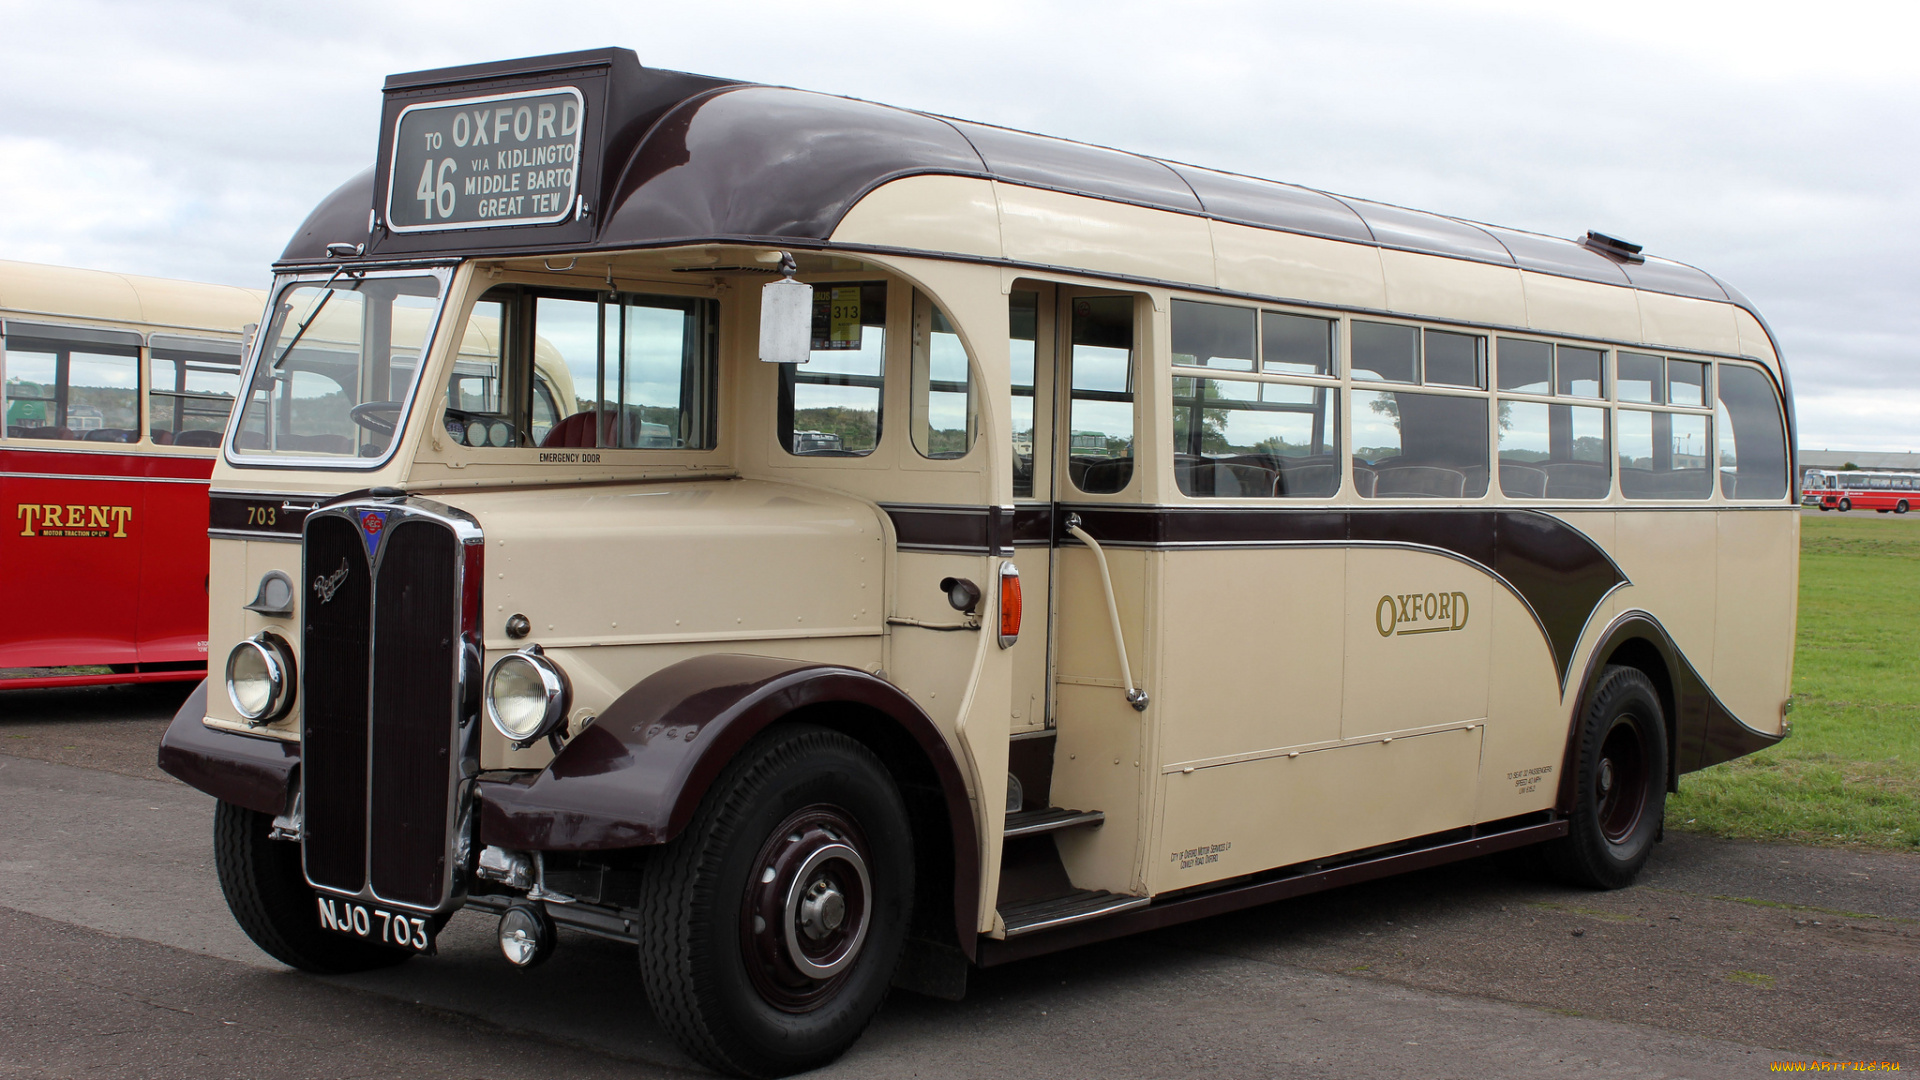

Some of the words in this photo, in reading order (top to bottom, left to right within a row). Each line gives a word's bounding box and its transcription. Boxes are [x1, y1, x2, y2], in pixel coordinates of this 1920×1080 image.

[425, 132, 443, 151] TO
[452, 101, 579, 148] OXFORD
[471, 158, 490, 172] VIA
[416, 157, 458, 220] 46
[465, 173, 521, 196] MIDDLE
[478, 196, 525, 218] GREAT
[531, 192, 561, 214] TEW
[833, 305, 859, 319] 313
[539, 453, 580, 463] EMERGENCY
[582, 453, 601, 463] DOOR
[17, 504, 133, 538] TRENT
[247, 506, 277, 526] 703
[1375, 591, 1469, 638] OXFORD
[1170, 852, 1179, 862] CITY
[1184, 849, 1197, 859] OXFORD
[1198, 846, 1210, 856] MOTOR
[1210, 844, 1226, 854] SERVICES
[1195, 857, 1204, 866] ROAD
[1205, 854, 1218, 864] OXFORD
[318, 897, 371, 937] NJO
[374, 909, 428, 951] 703
